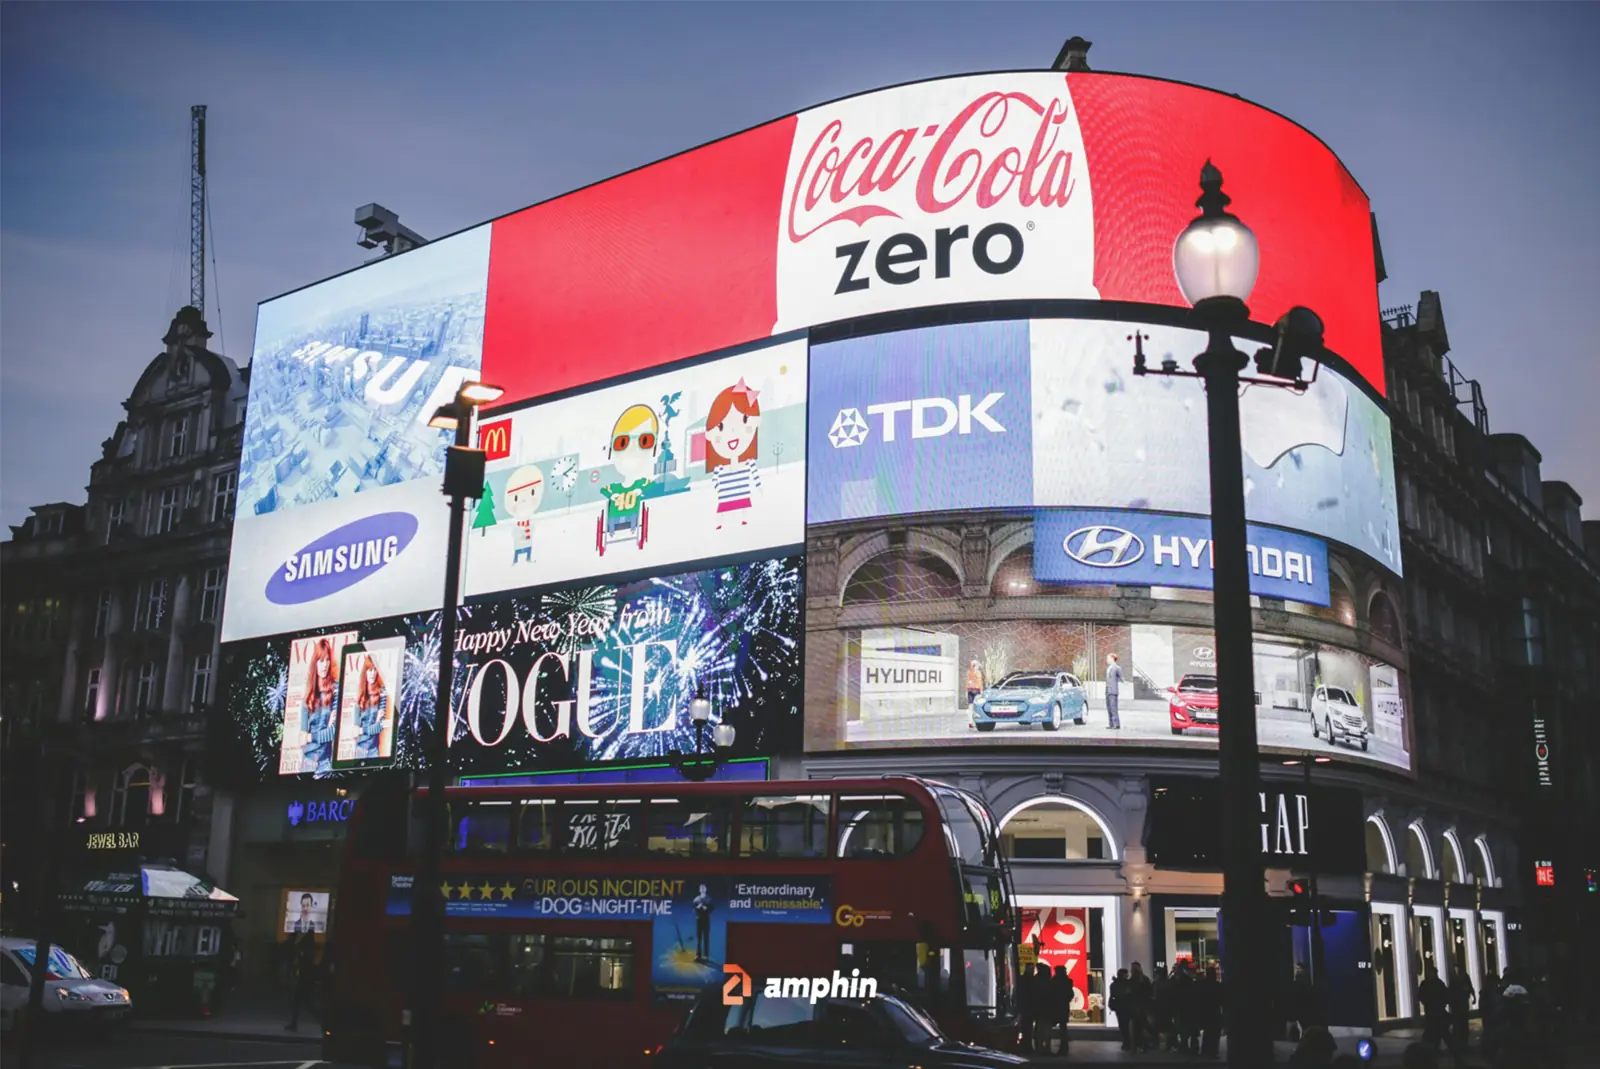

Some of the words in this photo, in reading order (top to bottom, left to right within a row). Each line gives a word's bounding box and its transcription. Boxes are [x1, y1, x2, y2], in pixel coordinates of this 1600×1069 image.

[788, 91, 1076, 243] Coca-Cola
[834, 222, 1025, 295] zero
[867, 392, 1007, 442] TDK
[284, 535, 398, 582] SAMSUNG
[515, 618, 561, 645] New
[567, 612, 613, 637] Year
[615, 603, 671, 635] from
[866, 667, 942, 684] HYUNDAI
[87, 833, 116, 849] JEWEL
[118, 832, 139, 848] BAR
[523, 878, 599, 897] CURIOUS
[602, 879, 685, 898] INCIDENT
[729, 898, 751, 909] and
[541, 897, 583, 915] DOG
[591, 898, 672, 916] NIGHT-TIME
